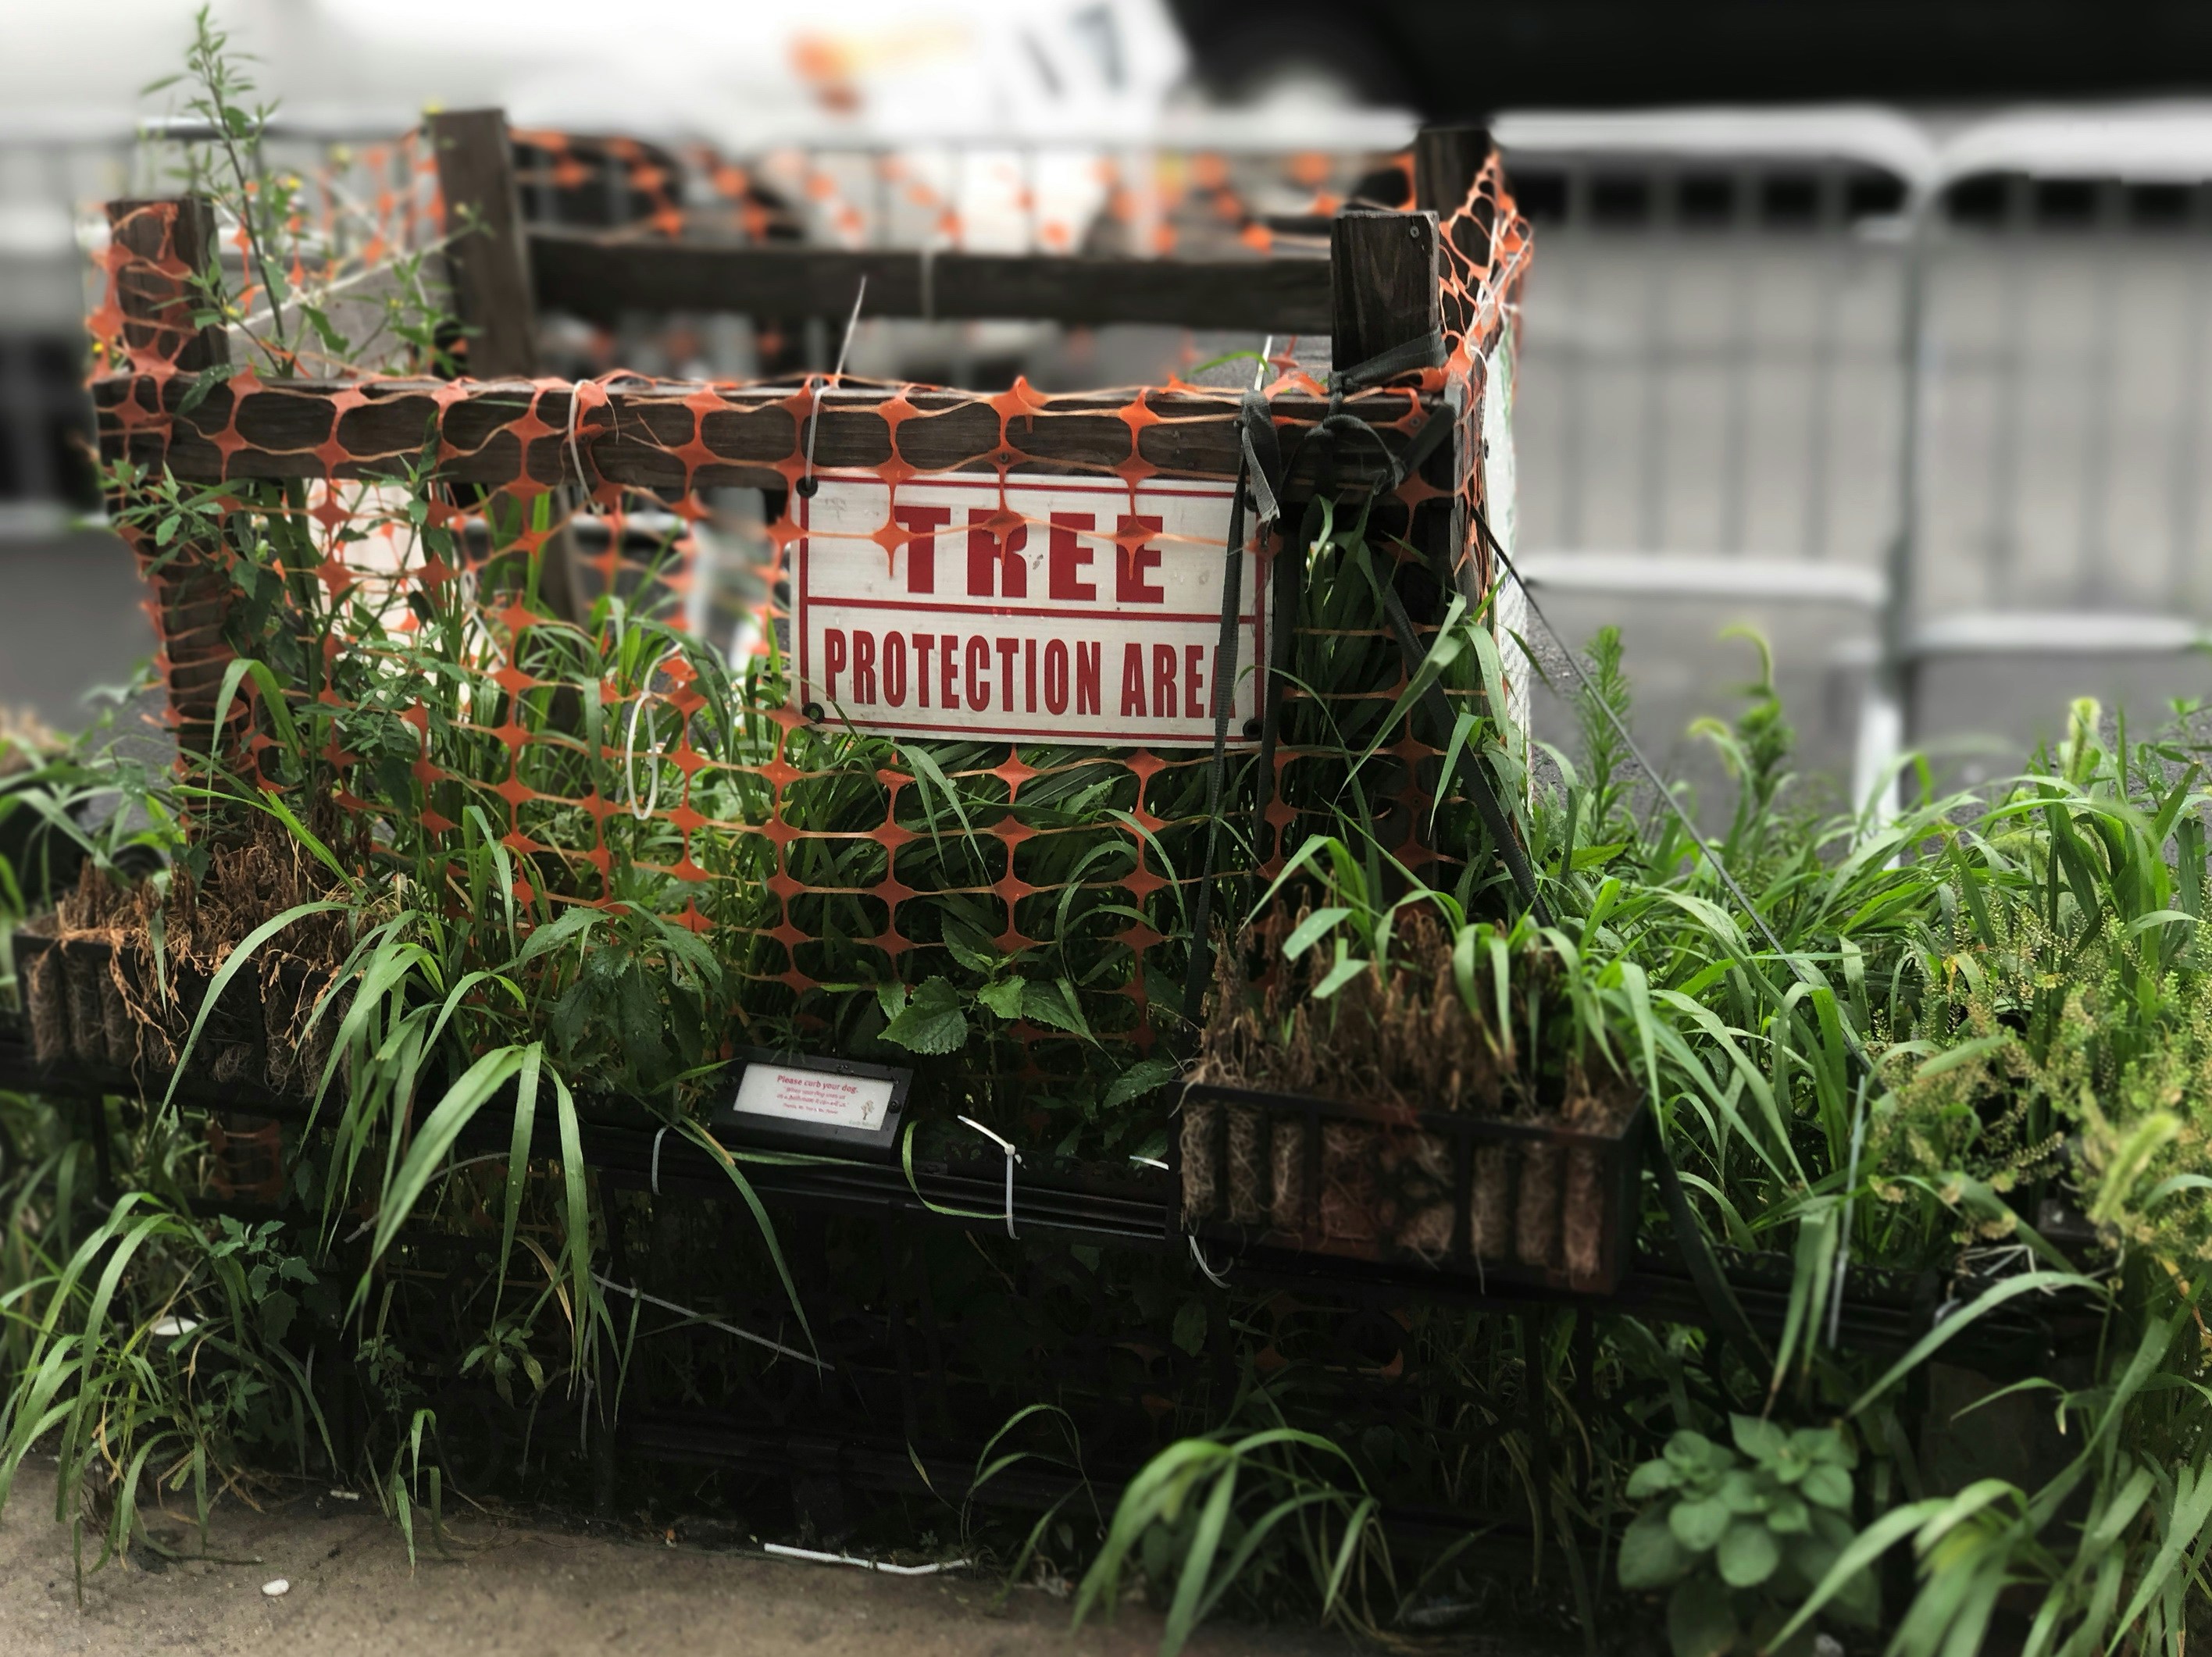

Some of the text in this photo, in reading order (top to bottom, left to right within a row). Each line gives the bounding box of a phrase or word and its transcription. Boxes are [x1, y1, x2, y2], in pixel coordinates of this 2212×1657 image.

[893, 505, 1164, 604] TREE
[823, 628, 1101, 716] PROTECTION
[777, 1074, 802, 1085] Please
[841, 1085, 859, 1094] dog.
